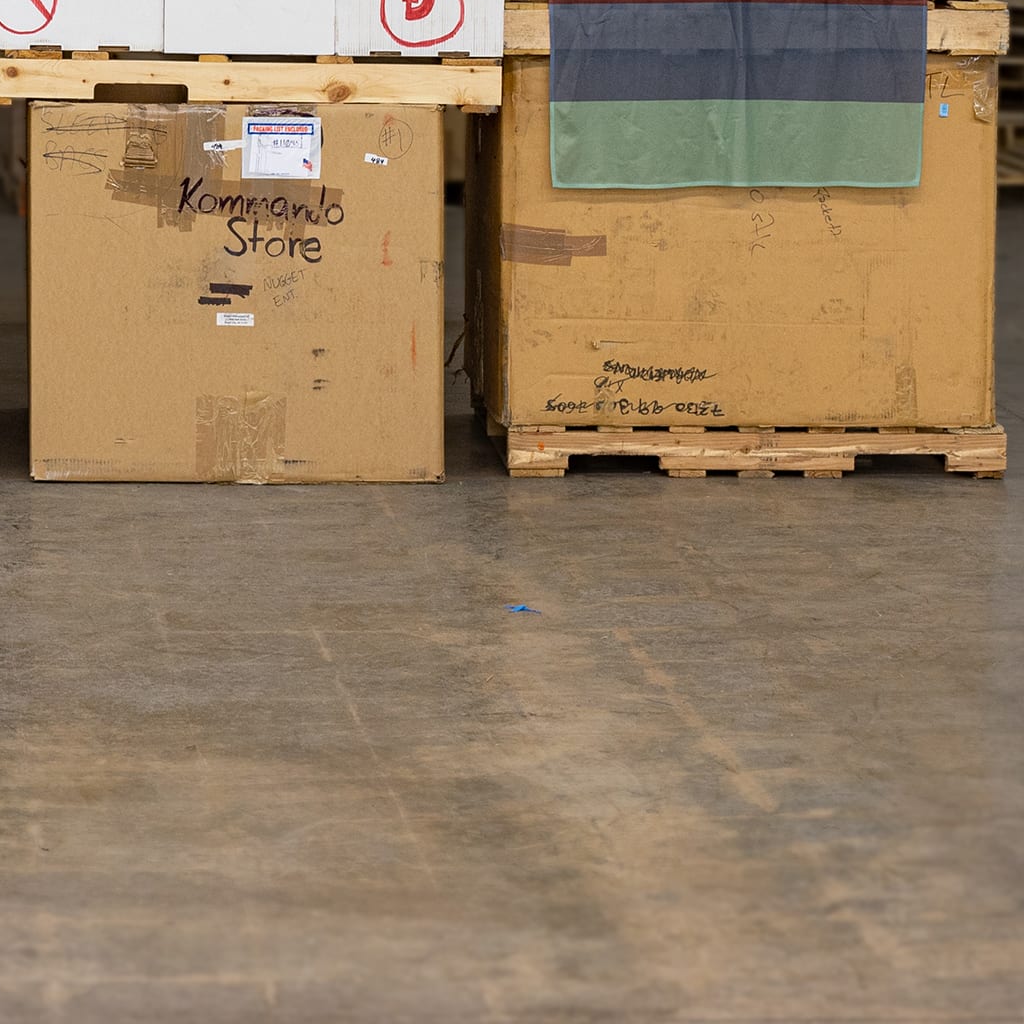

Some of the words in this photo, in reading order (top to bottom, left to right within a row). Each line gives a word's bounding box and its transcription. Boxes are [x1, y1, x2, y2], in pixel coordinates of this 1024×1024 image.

[177, 176, 345, 226] Kommando
[223, 215, 322, 263] Store
[263, 269, 307, 292] NUGGET
